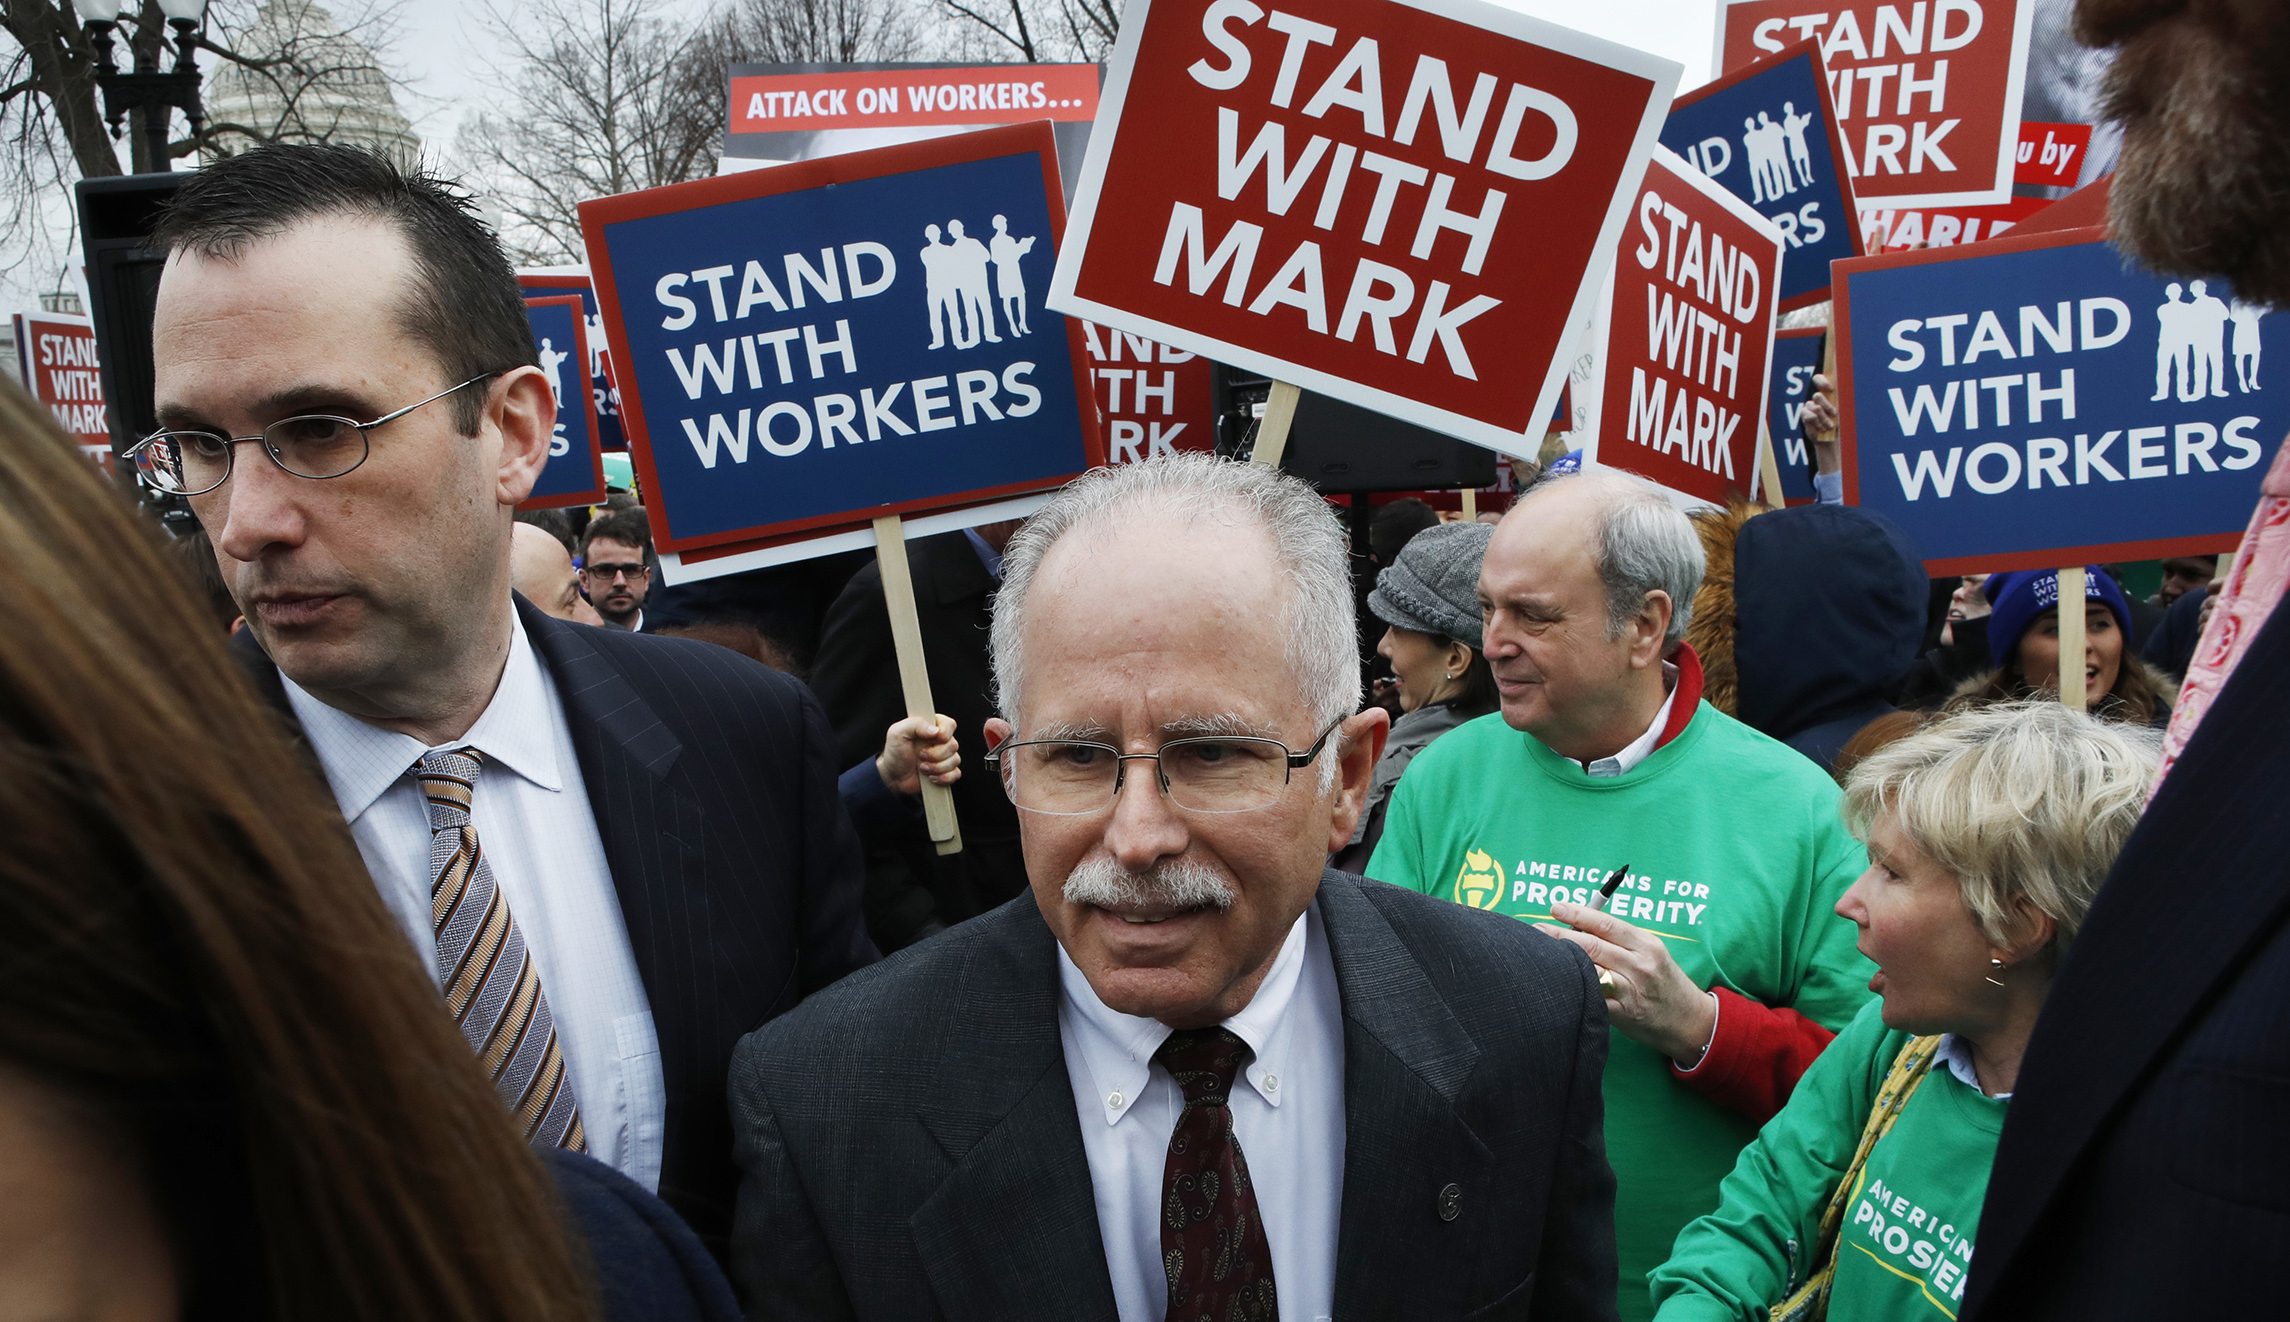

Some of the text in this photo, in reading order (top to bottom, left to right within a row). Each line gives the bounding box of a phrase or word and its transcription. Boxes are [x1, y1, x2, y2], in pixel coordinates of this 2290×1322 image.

[746, 81, 1083, 120] ATTACK ON WORKERS...
[1187, 0, 1579, 181] STAND
[1827, 59, 1949, 120] ITH
[1840, 118, 1962, 178] RK
[2039, 131, 2077, 176] by
[1217, 106, 1508, 277] WITH
[655, 241, 897, 331] STAND
[1153, 200, 1503, 382] MARK
[1636, 190, 1760, 324] STAND
[665, 318, 858, 400] WITH
[1648, 282, 1742, 400] WITH
[1887, 296, 2132, 372] STAND
[50, 369, 102, 401] WITH
[680, 361, 1042, 469] WORKERS
[1887, 368, 2076, 436] WITH
[1109, 420, 1188, 464] RK
[1626, 366, 1742, 482] MARK
[1890, 415, 2263, 501] WORKERS
[2033, 574, 2059, 590] STA
[2034, 583, 2059, 597] WIT
[1512, 880, 1707, 926] PROSERITY
[1663, 880, 1711, 900] FOR
